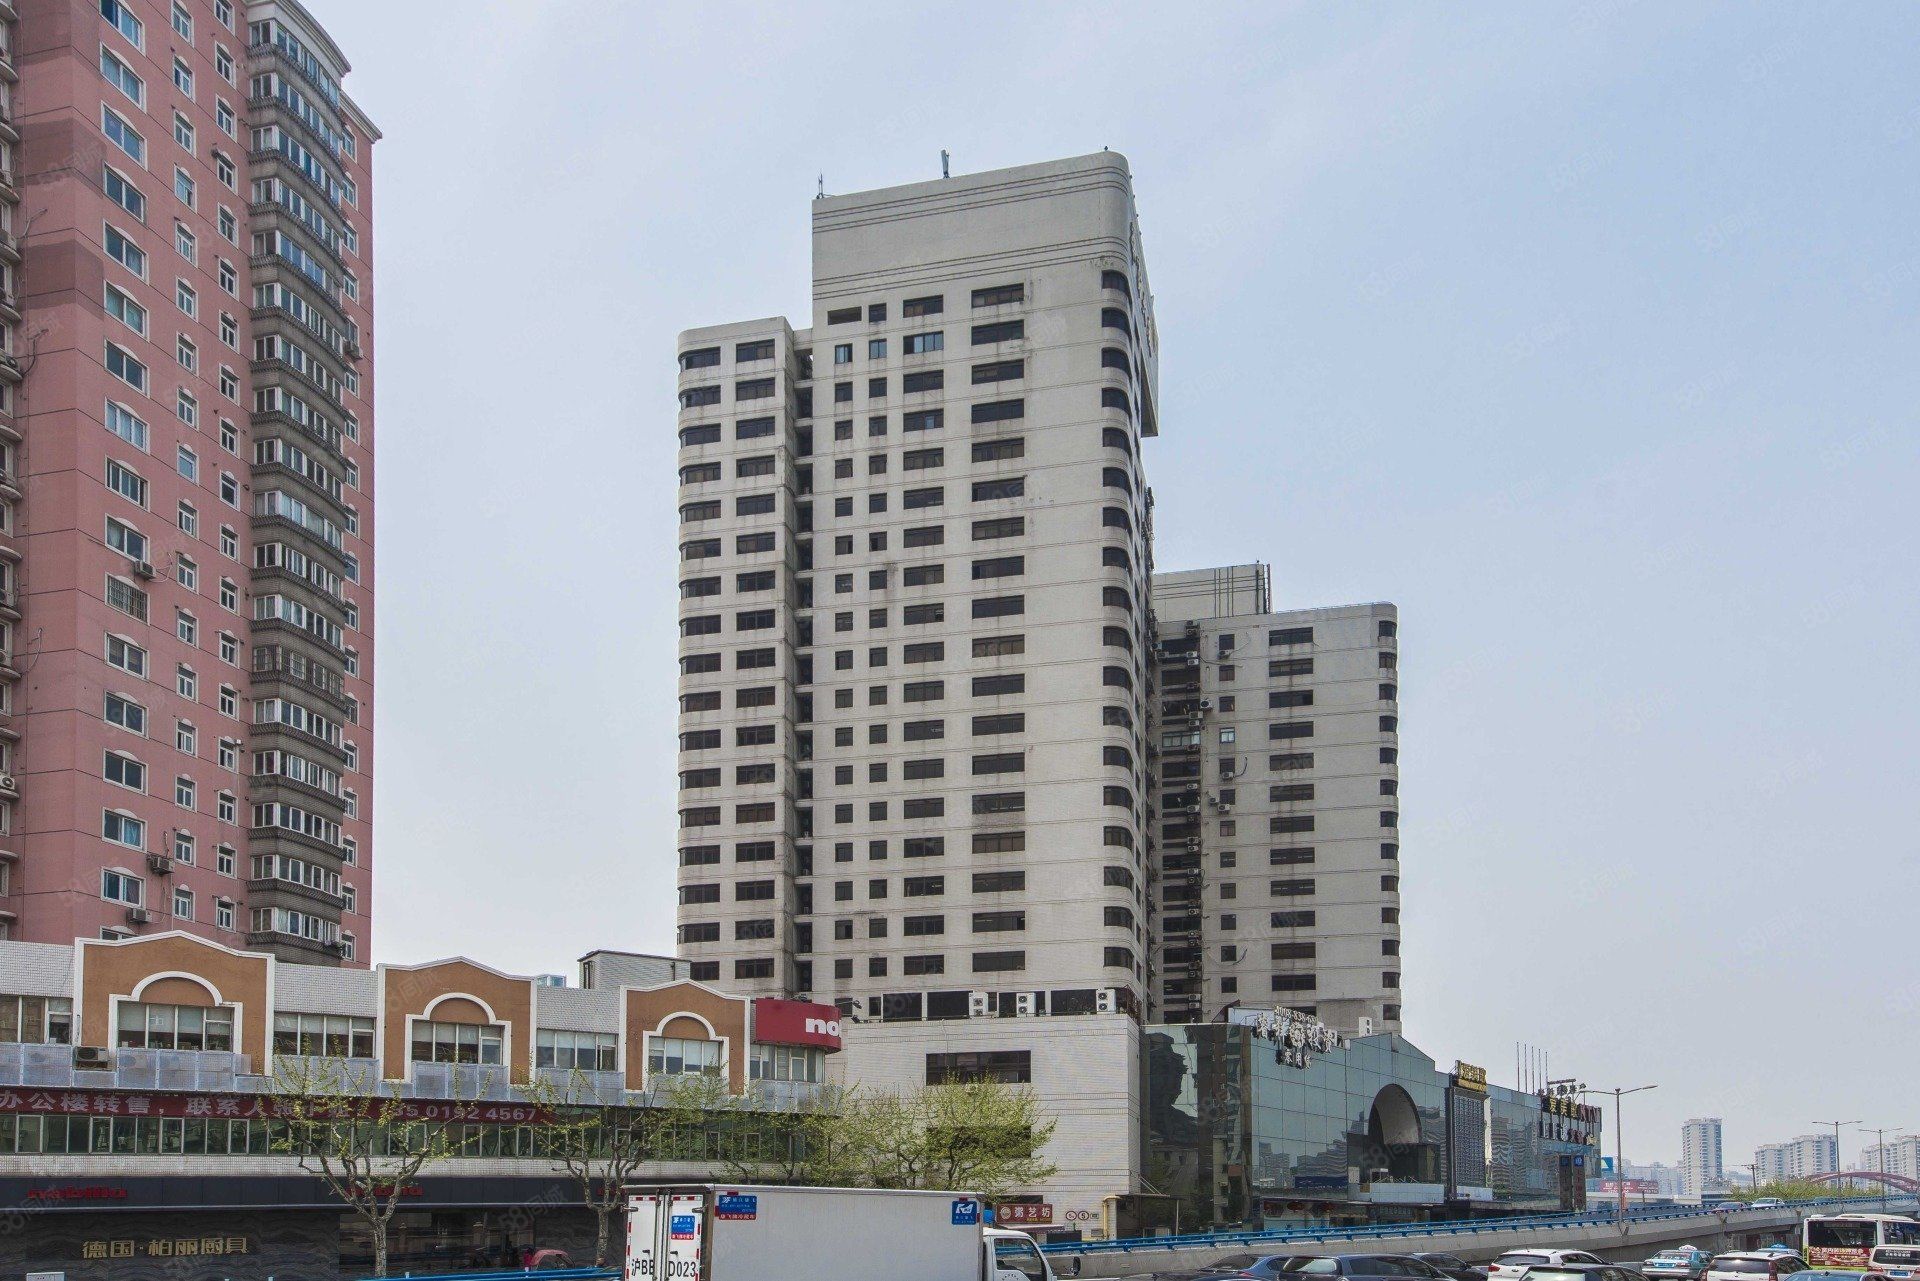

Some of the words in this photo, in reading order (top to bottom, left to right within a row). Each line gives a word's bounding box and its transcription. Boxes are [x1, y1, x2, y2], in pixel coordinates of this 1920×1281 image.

[485, 1107, 537, 1120] 4567
[1014, 1206, 1050, 1218] 粥艺坊
